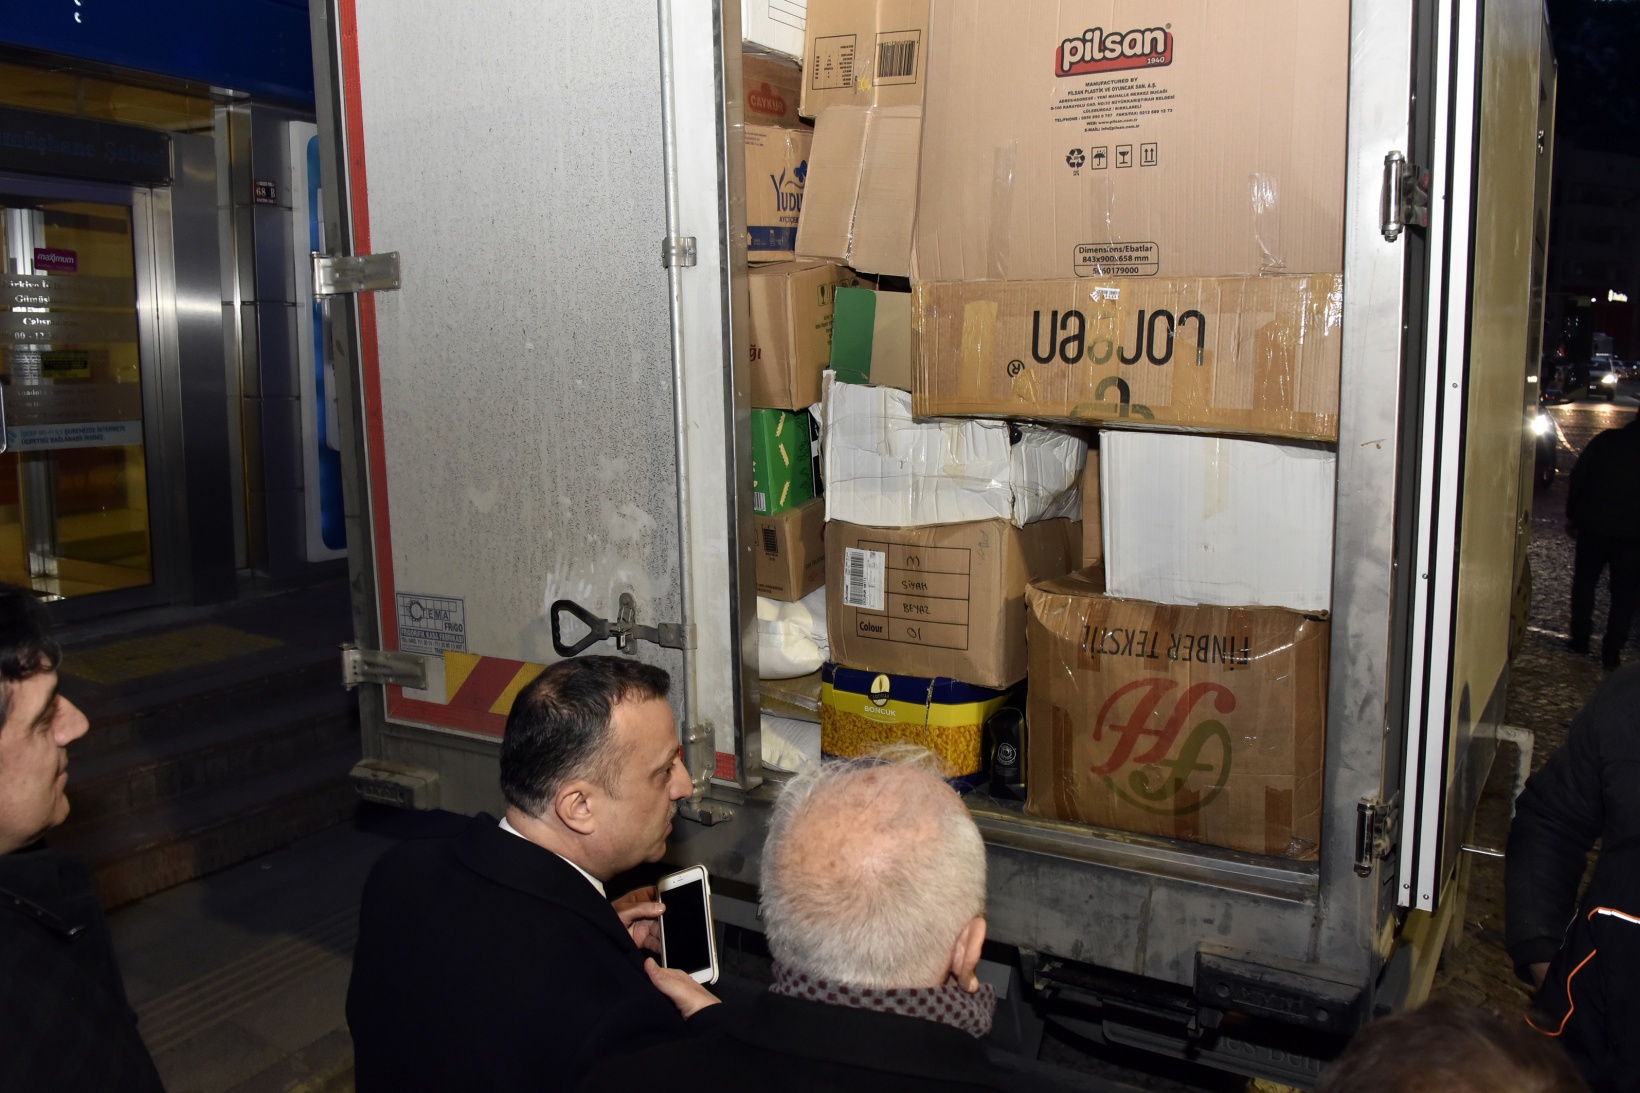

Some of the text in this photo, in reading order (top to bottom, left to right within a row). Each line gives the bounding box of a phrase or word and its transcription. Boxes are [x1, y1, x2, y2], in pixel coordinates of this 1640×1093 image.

[1061, 27, 1167, 72] pilsan
[1085, 78, 1129, 87] MANUFACTURED
[1079, 245, 1152, 254] Dimensions/Ebatlar
[38, 254, 74, 264] maximum
[859, 621, 883, 634] Colour
[1167, 632, 1249, 672] FİNBER
[864, 705, 896, 717] BONCUK
